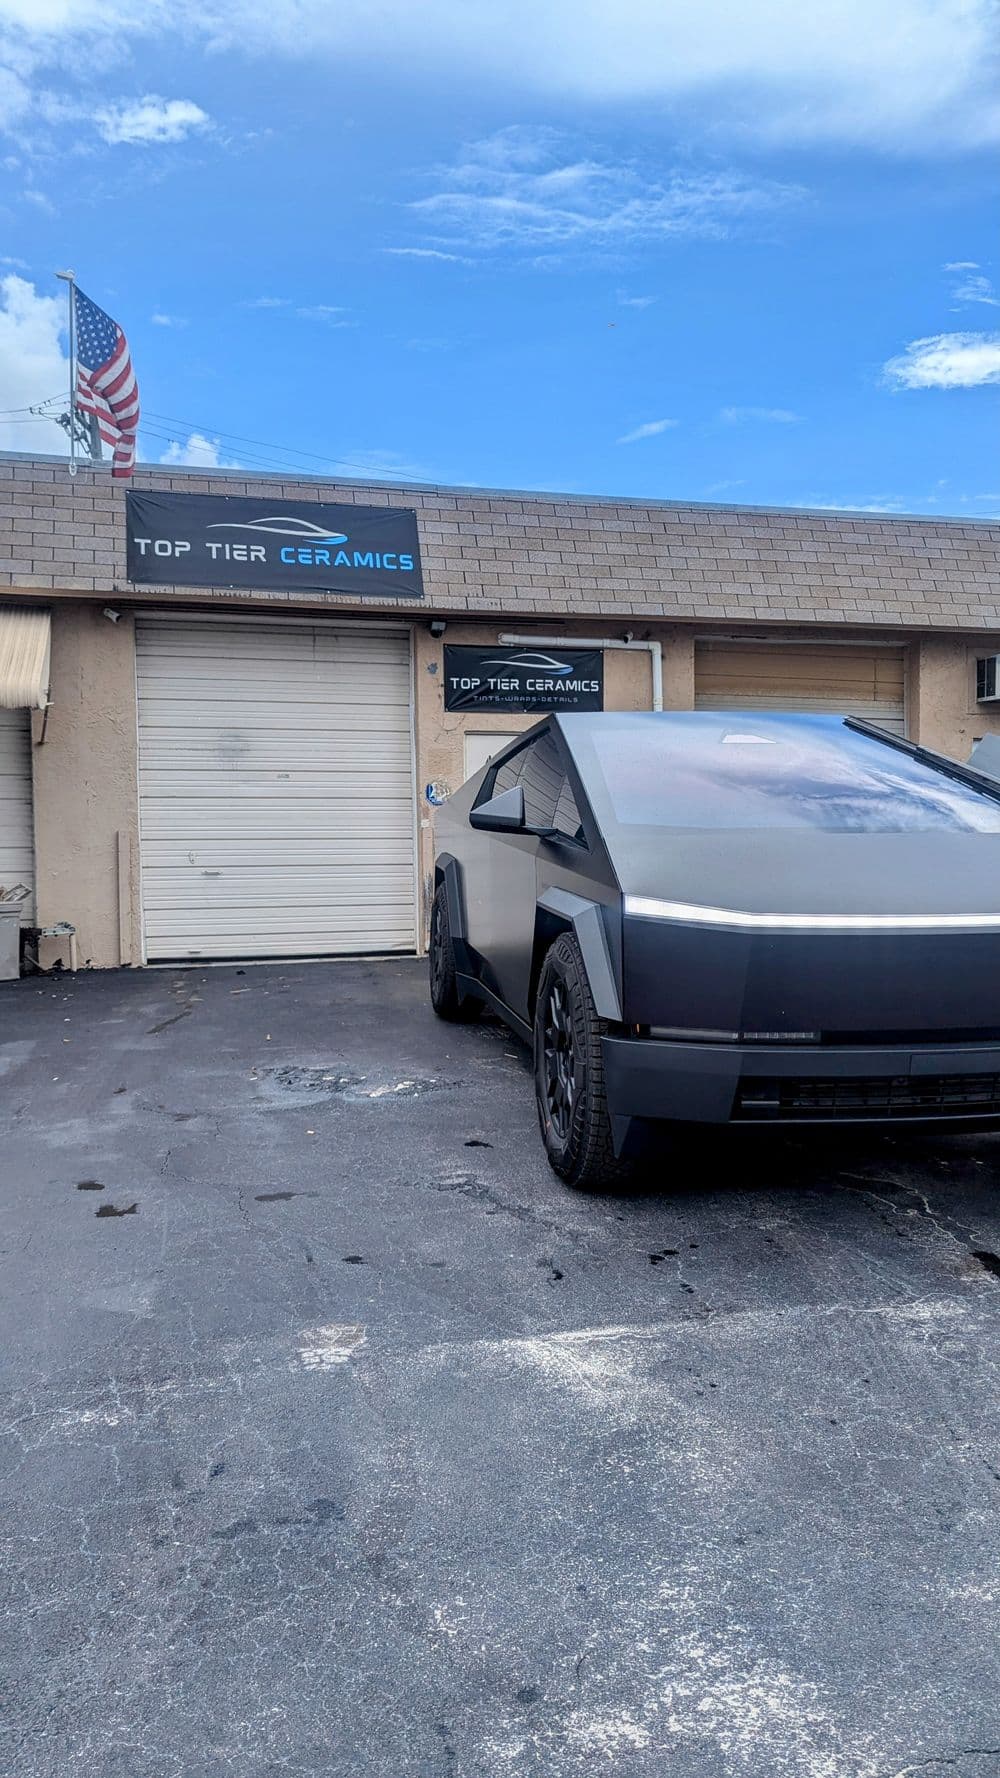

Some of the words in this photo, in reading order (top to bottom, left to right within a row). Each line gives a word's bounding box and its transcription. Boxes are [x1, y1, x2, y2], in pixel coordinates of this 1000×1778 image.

[134, 538, 191, 557] TOP
[206, 542, 267, 562] TIER
[280, 547, 414, 571] CERAMICS
[450, 677, 481, 690] TOP
[487, 678, 520, 691] TIER
[526, 679, 599, 692] CERAMICS
